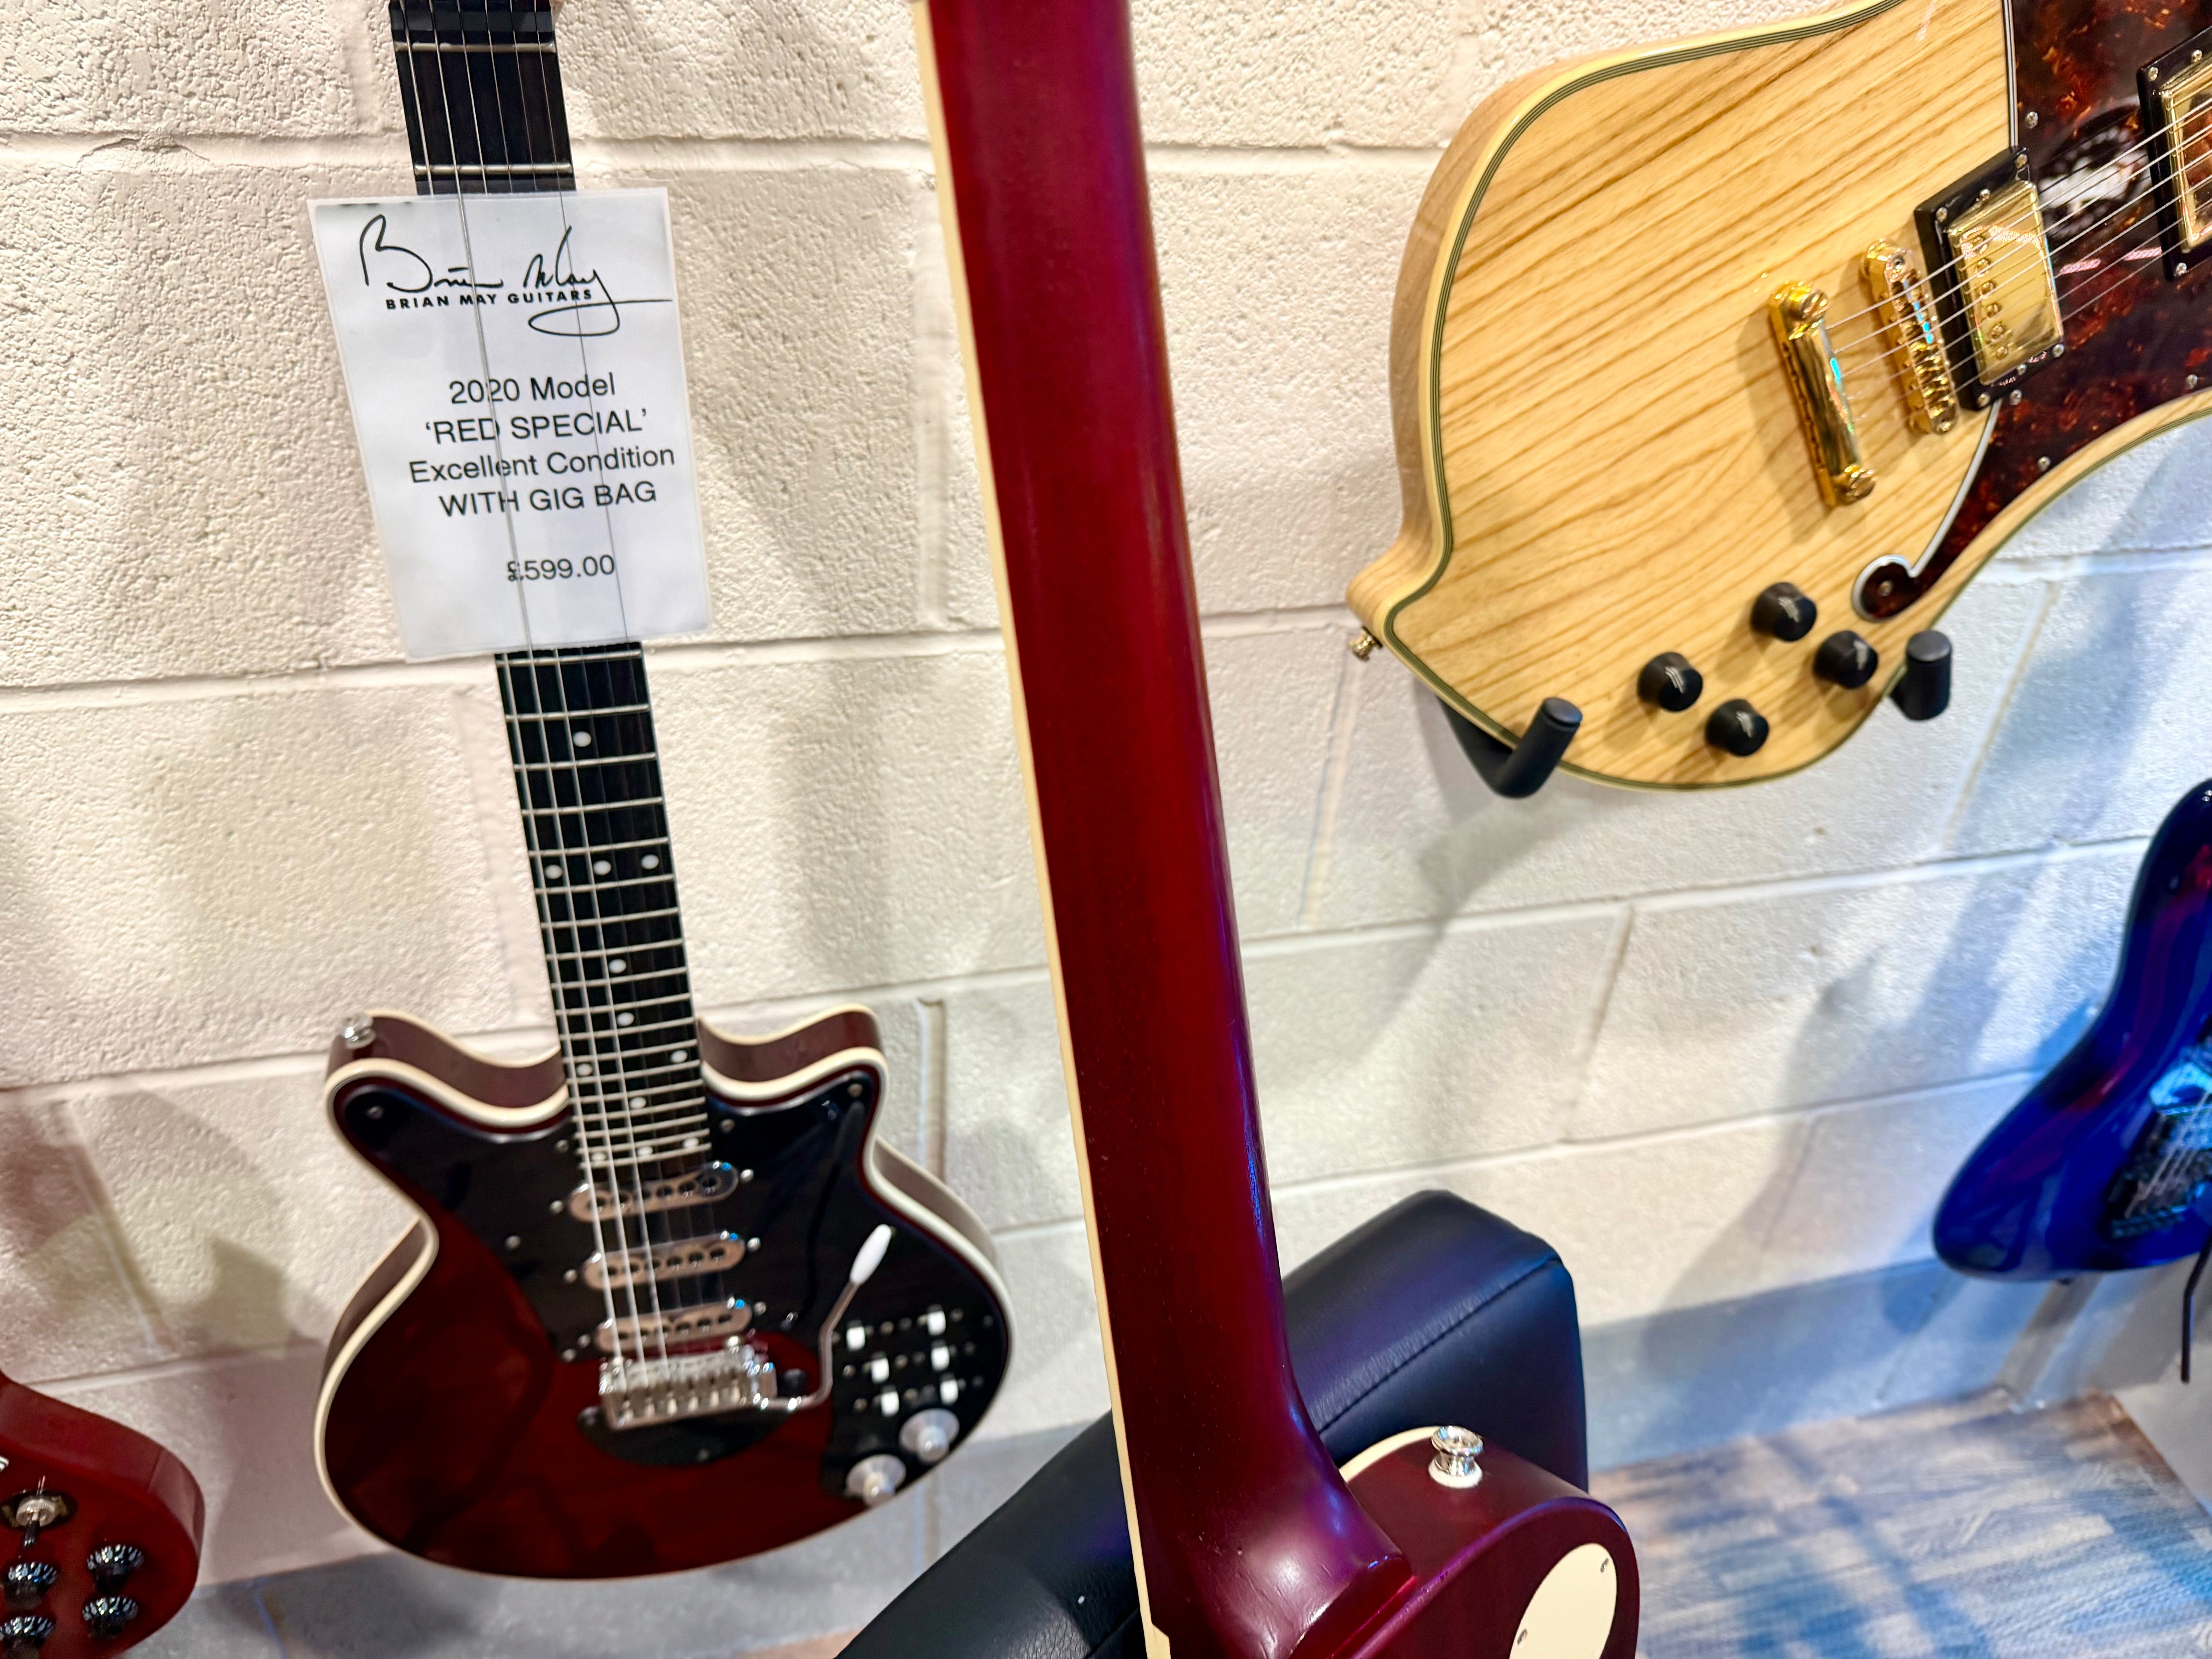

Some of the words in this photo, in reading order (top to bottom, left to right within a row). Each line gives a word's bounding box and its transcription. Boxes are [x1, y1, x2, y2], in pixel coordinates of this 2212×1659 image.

[386, 295, 449, 310] BRIAN
[459, 293, 497, 305] MAY
[508, 289, 592, 304] GUITARS
[449, 378, 520, 404] 2020
[530, 372, 616, 401] Model
[425, 417, 500, 444] ‘RED
[510, 408, 647, 440] SPECIAL’
[409, 455, 539, 483] Excellent
[546, 446, 675, 475] Condition
[439, 490, 520, 517] WITH
[529, 488, 584, 511] GIG
[594, 481, 656, 507] BAG
[507, 555, 615, 582] £599.00
